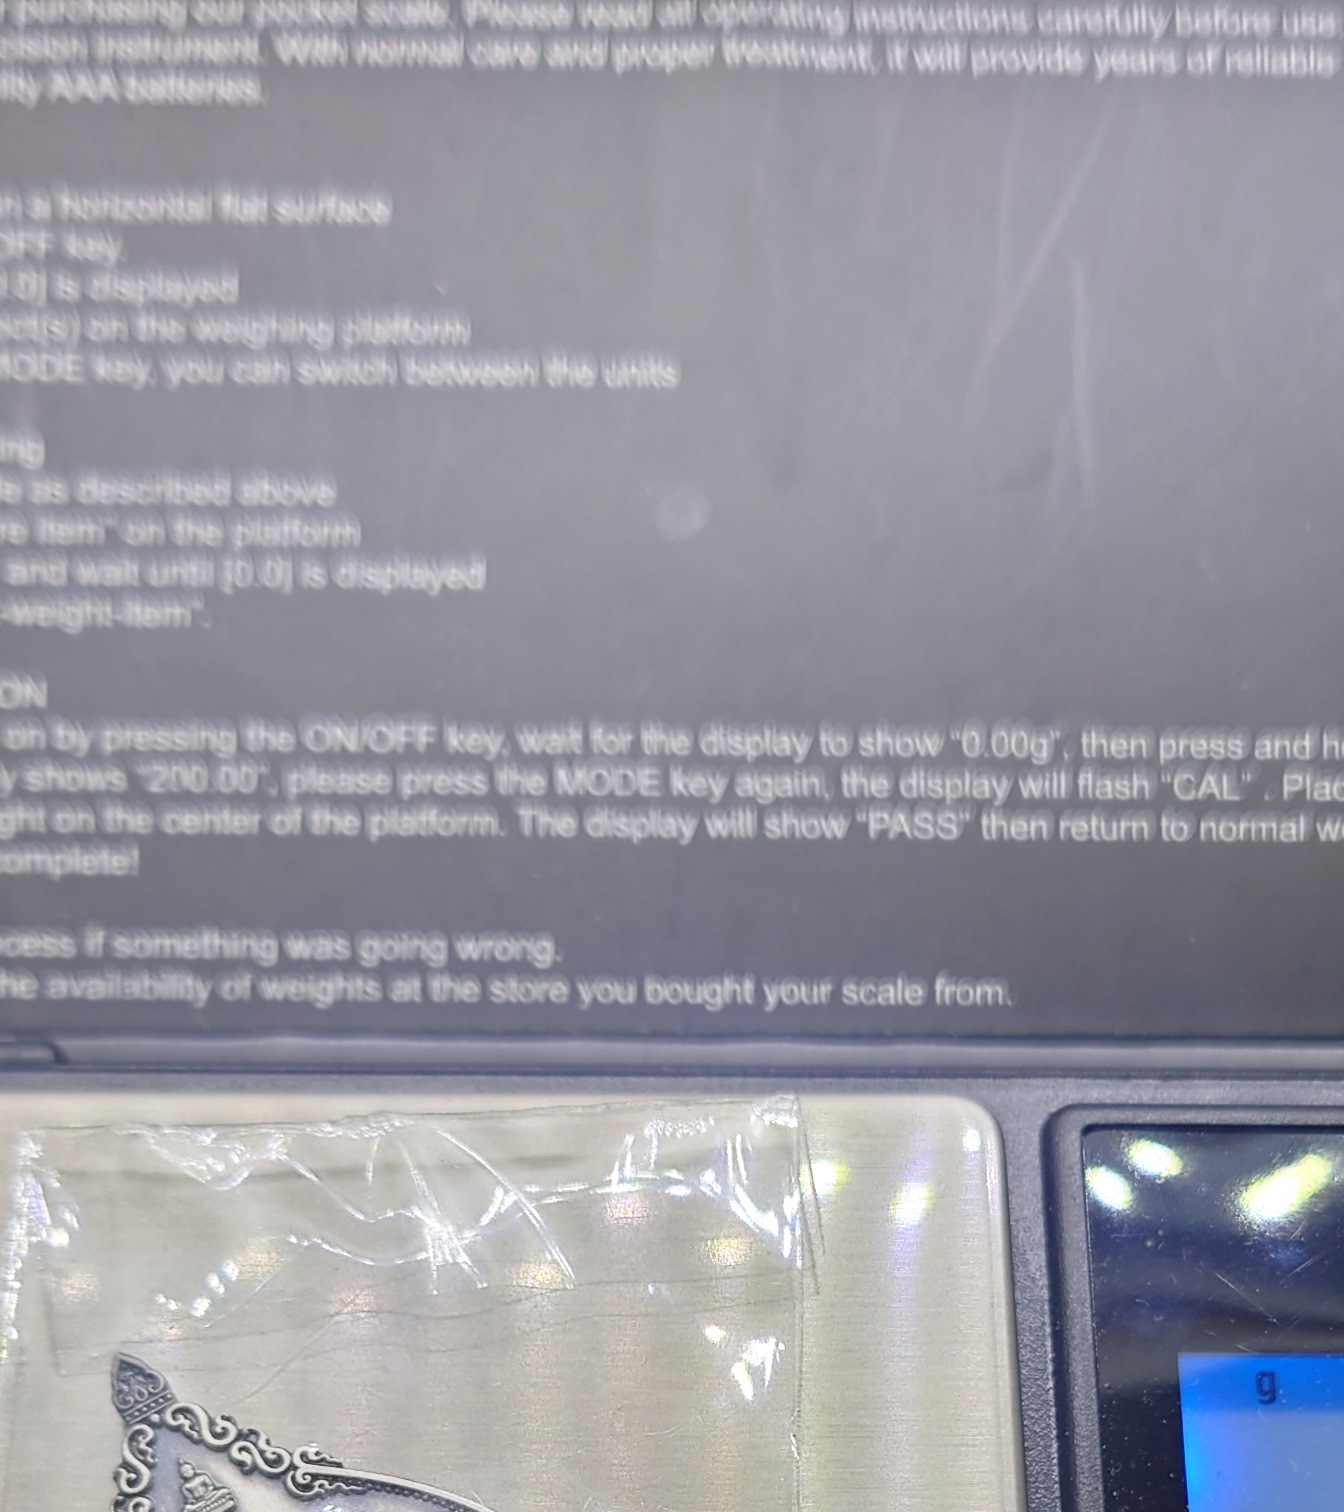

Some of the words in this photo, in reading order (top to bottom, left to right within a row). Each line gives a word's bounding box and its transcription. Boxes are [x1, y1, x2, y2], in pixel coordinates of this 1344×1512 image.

[95, 719, 239, 760] pressing
[240, 720, 298, 753] the
[514, 722, 584, 755] wait
[588, 722, 634, 756] for
[638, 722, 693, 756] the
[696, 723, 814, 765] display
[816, 723, 852, 758] to
[856, 724, 946, 758] show
[1078, 725, 1156, 760] then
[1159, 730, 1251, 768] press
[1253, 725, 1319, 761] and
[281, 762, 393, 804] please
[394, 768, 490, 805] press
[492, 764, 551, 797] the
[553, 765, 664, 797] MODE
[667, 766, 731, 806] key
[839, 766, 897, 799] the
[898, 767, 1016, 807] display
[1018, 767, 1074, 800] will
[1076, 767, 1156, 800] flash
[49, 807, 99, 835] on
[101, 802, 158, 835] the
[160, 803, 261, 836] center
[266, 803, 306, 837] of
[309, 804, 365, 837] the
[516, 806, 582, 838] The
[584, 806, 700, 847] display
[702, 807, 759, 839] will
[761, 808, 853, 840] show
[979, 809, 1058, 841] then
[1058, 810, 1156, 842] return
[1159, 810, 1196, 842] to
[1199, 810, 1313, 843] normal
[109, 926, 281, 968] something
[283, 933, 354, 961] was
[358, 928, 449, 969] going
[454, 935, 564, 970] wrong.
[41, 966, 216, 1008] availability
[218, 967, 256, 1001] of
[258, 967, 386, 1009] weights
[389, 968, 426, 1002] at
[428, 968, 484, 1002] the
[487, 968, 572, 1003] store
[574, 974, 641, 1011] you
[643, 969, 756, 1012] bought
[763, 975, 836, 1013] your
[839, 970, 927, 1005] scale
[933, 971, 1016, 1006] from.
[1256, 1371, 1277, 1404] g
